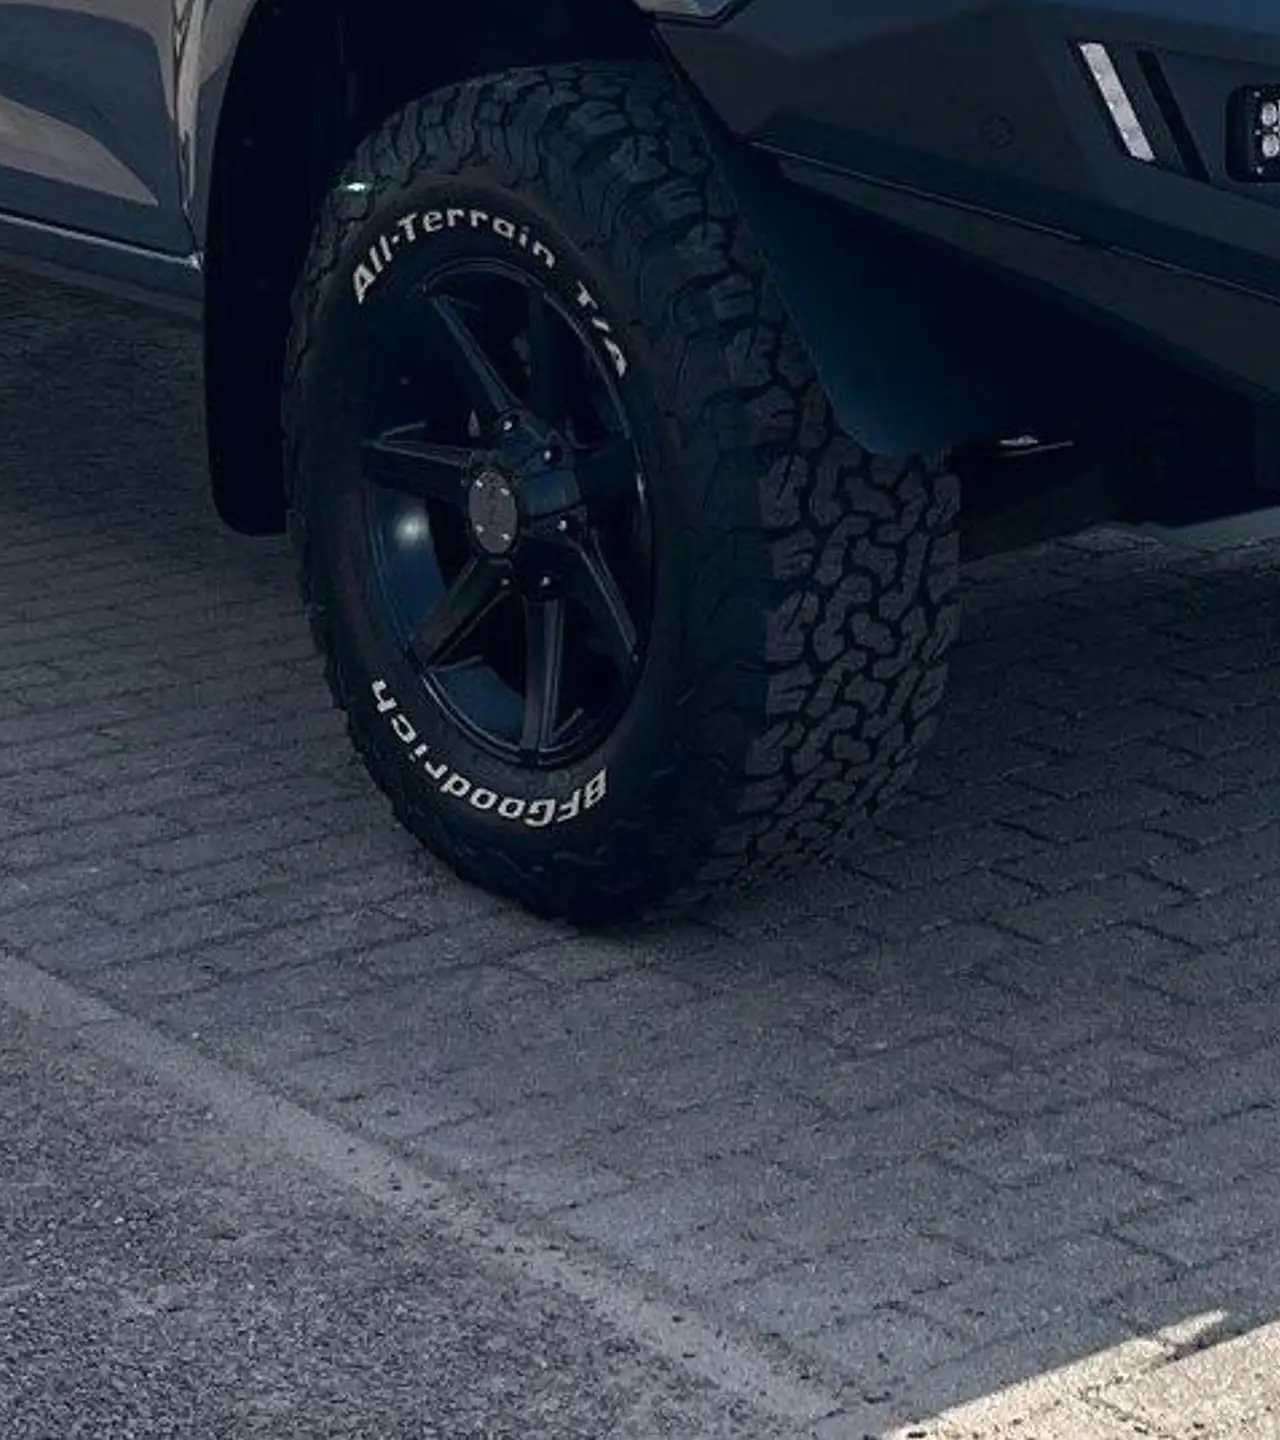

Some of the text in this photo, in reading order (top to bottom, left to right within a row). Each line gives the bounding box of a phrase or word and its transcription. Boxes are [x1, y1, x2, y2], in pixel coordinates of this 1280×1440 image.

[350, 206, 628, 378] All-Terrain T/A
[371, 679, 607, 828] BFGoodrich
